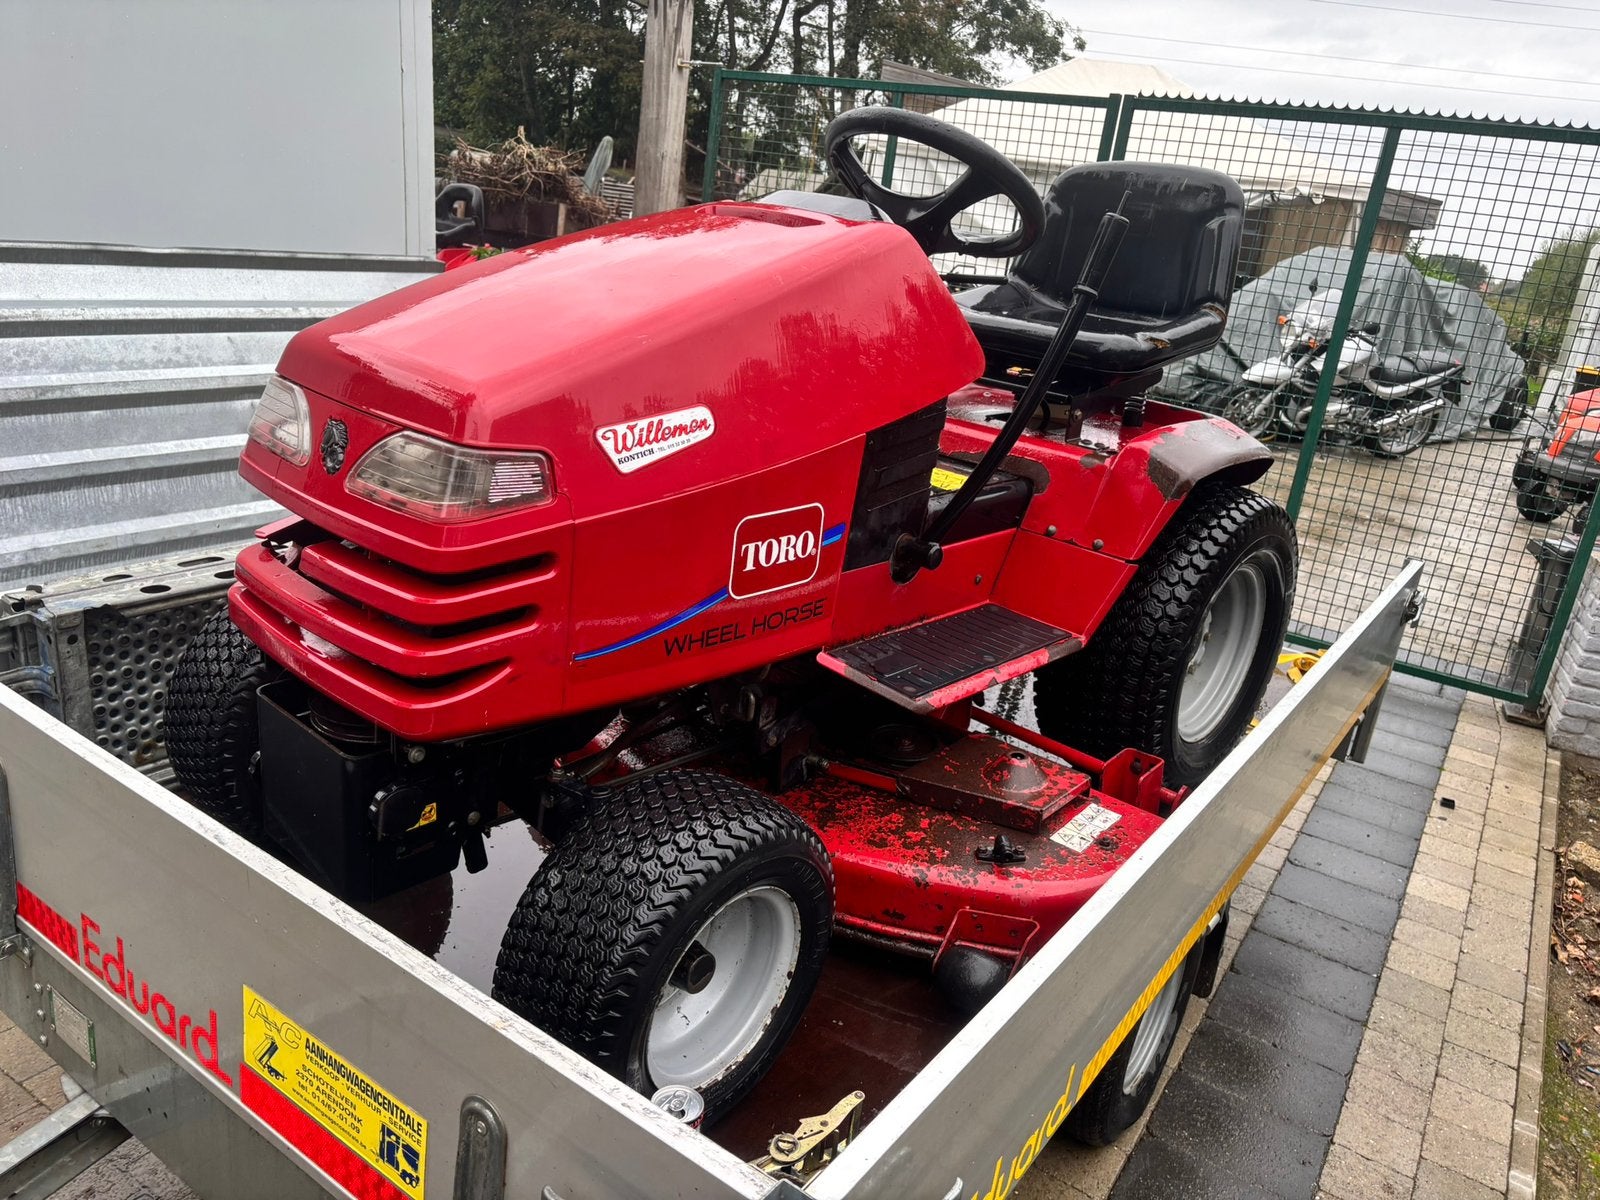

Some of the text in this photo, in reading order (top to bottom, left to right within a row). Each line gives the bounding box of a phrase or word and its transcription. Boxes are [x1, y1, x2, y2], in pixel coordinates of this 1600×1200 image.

[617, 447, 655, 465] KONTICH
[663, 598, 828, 657] WHEEL HORSE
[80, 912, 233, 1088] Eduard
[295, 1068, 364, 1127] 2370 ARENDONK
[301, 1063, 357, 1112] SCHOTELVEN
[304, 1037, 423, 1138] AANHANGWAGENCENTRALE
[305, 1053, 341, 1083] VERKOOP
[345, 1082, 382, 1116] VERHUUR
[388, 1116, 422, 1148] SERVICE
[970, 1062, 1077, 1200] duard
